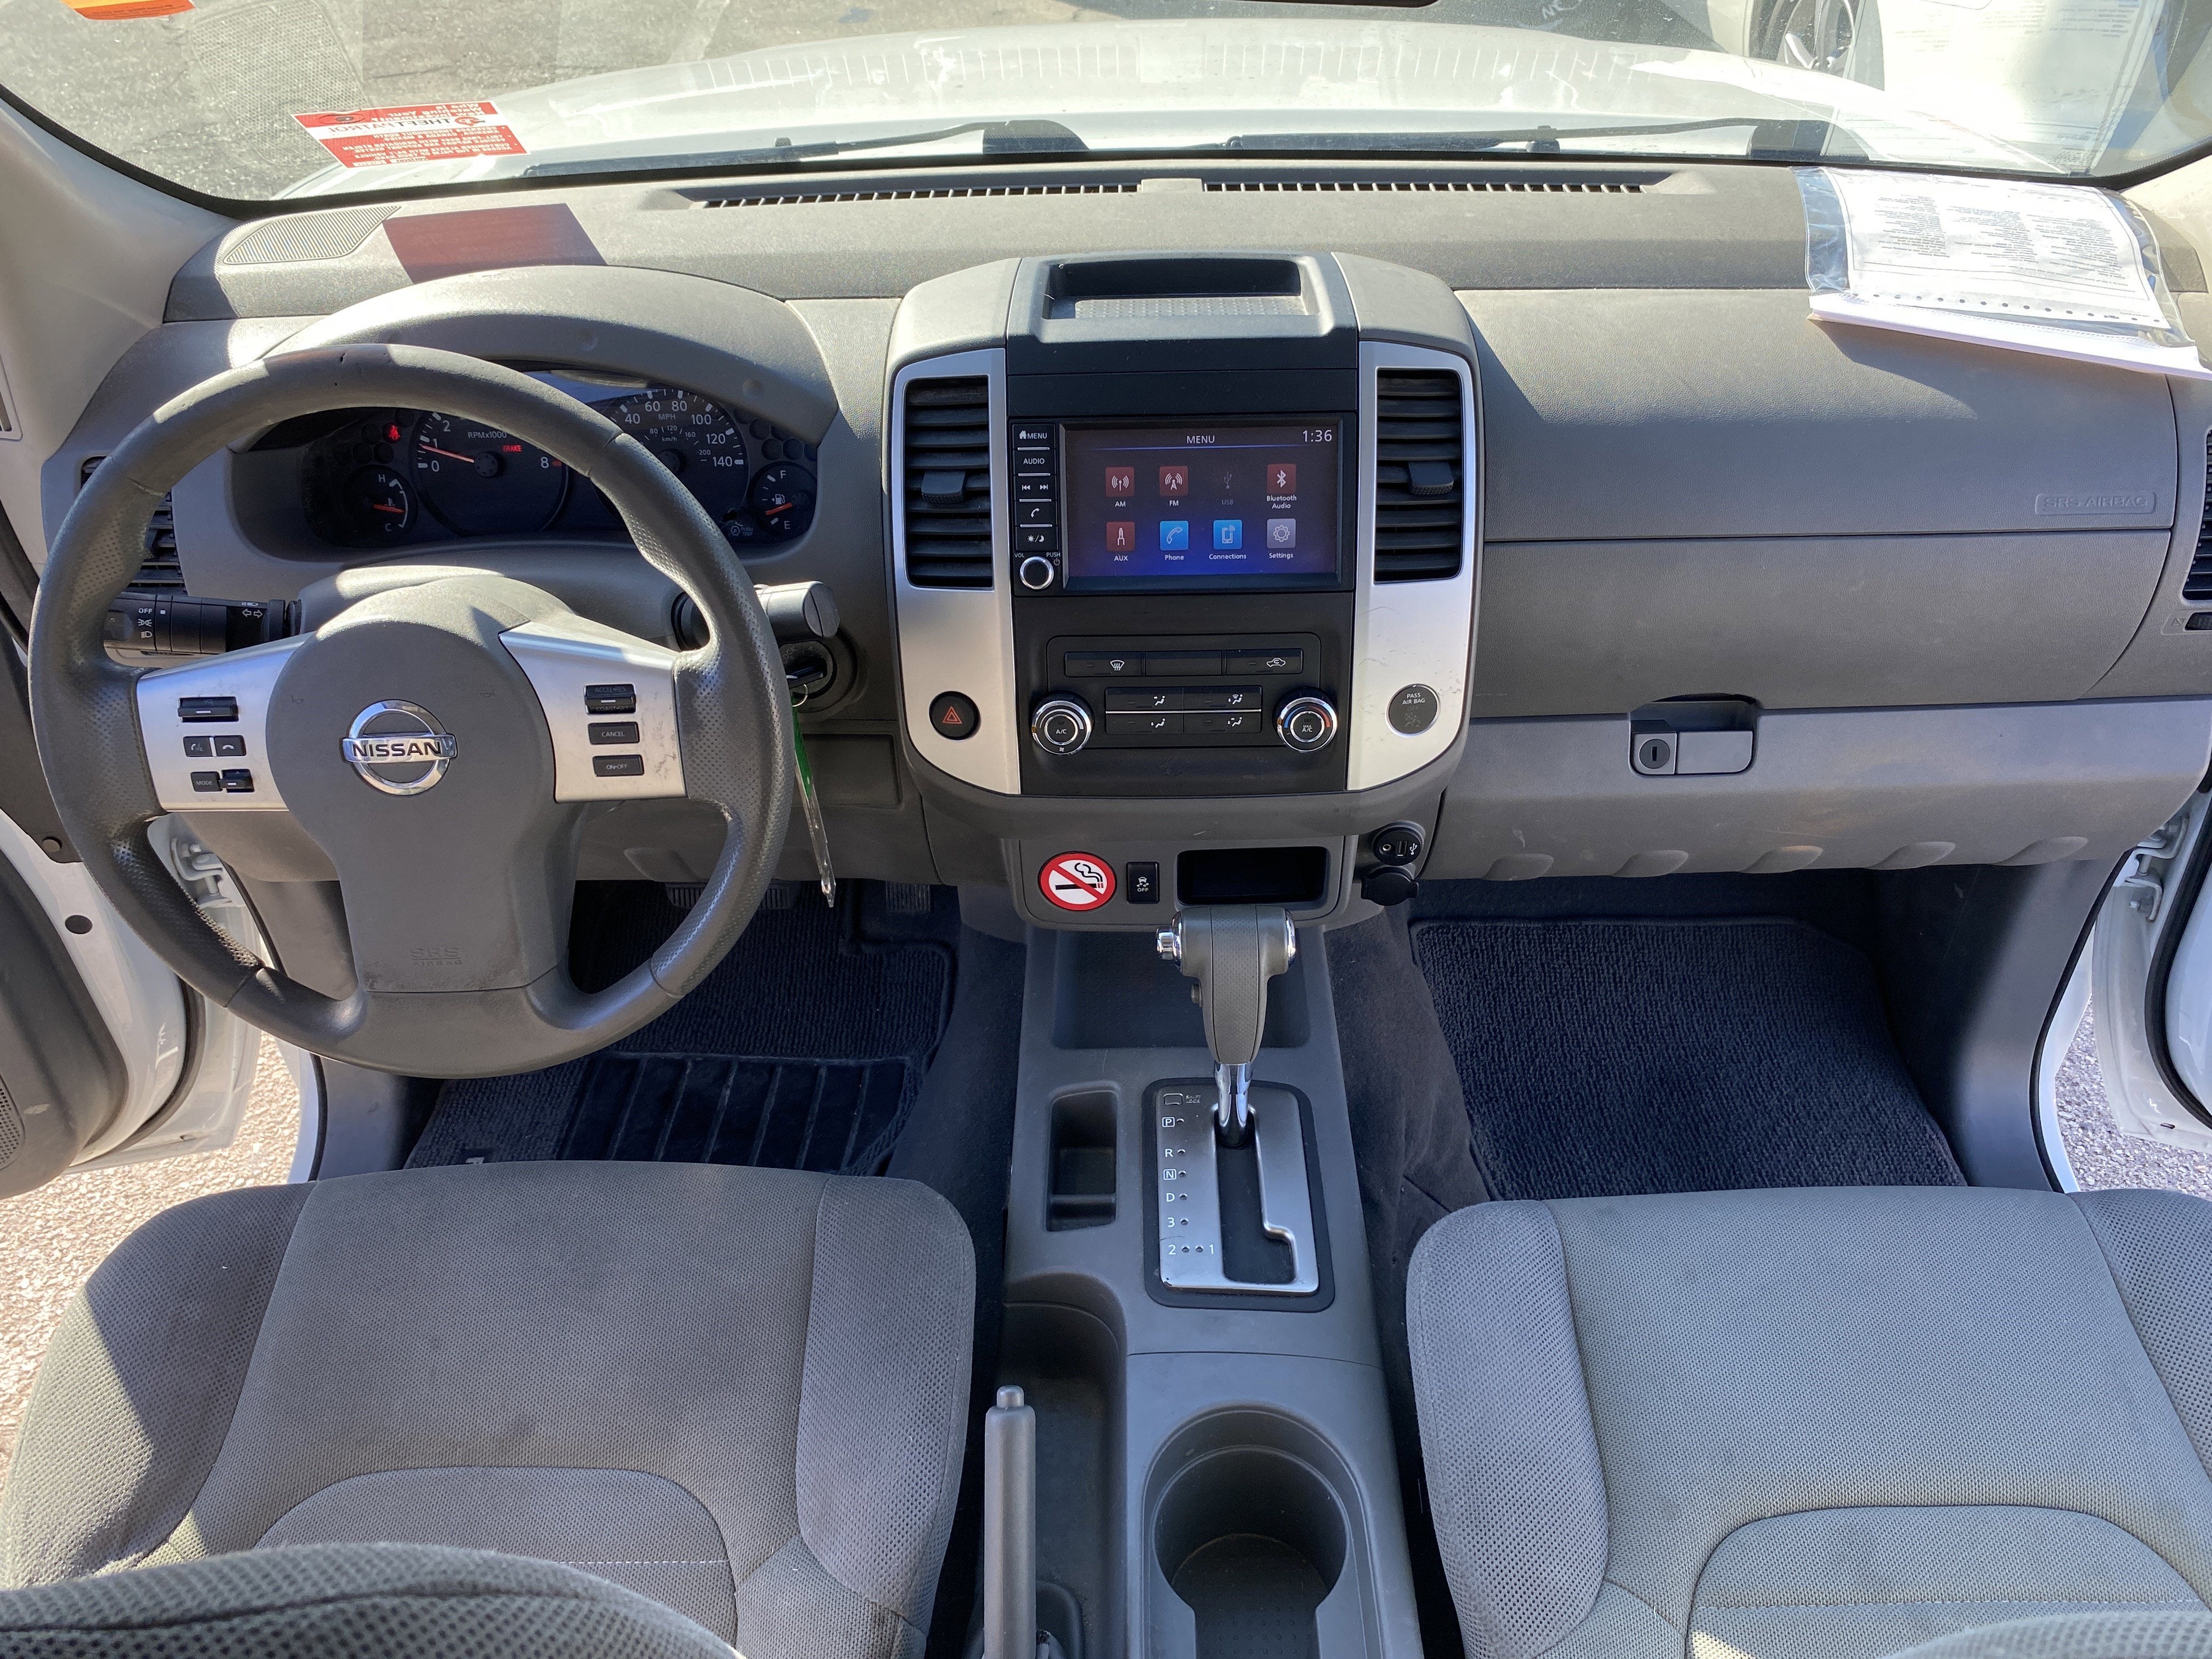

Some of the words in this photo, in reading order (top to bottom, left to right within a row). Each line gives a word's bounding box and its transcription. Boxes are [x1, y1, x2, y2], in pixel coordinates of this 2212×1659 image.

[645, 400, 660, 411] 60
[672, 400, 687, 411] 80
[624, 413, 640, 424] 40
[691, 414, 712, 425] 100
[442, 420, 450, 432] 2
[706, 433, 725, 444] 120
[1186, 435, 1215, 444] MENU
[1302, 430, 1333, 443] 1:36
[432, 438, 437, 448] 1
[431, 460, 439, 472] 0
[540, 456, 549, 469] 8
[713, 456, 732, 467] 140
[379, 473, 385, 483] H
[780, 470, 786, 479] F
[2085, 496, 2148, 507] AIRBAG
[385, 523, 392, 531] C
[784, 521, 790, 529] E
[1268, 552, 1294, 561] Settings
[352, 742, 441, 757] NISSAN
[1165, 1149, 1173, 1157] R
[1166, 1193, 1175, 1202] D
[1167, 1217, 1175, 1227] 3
[1168, 1244, 1176, 1255] 2
[1209, 1244, 1214, 1255] 1
